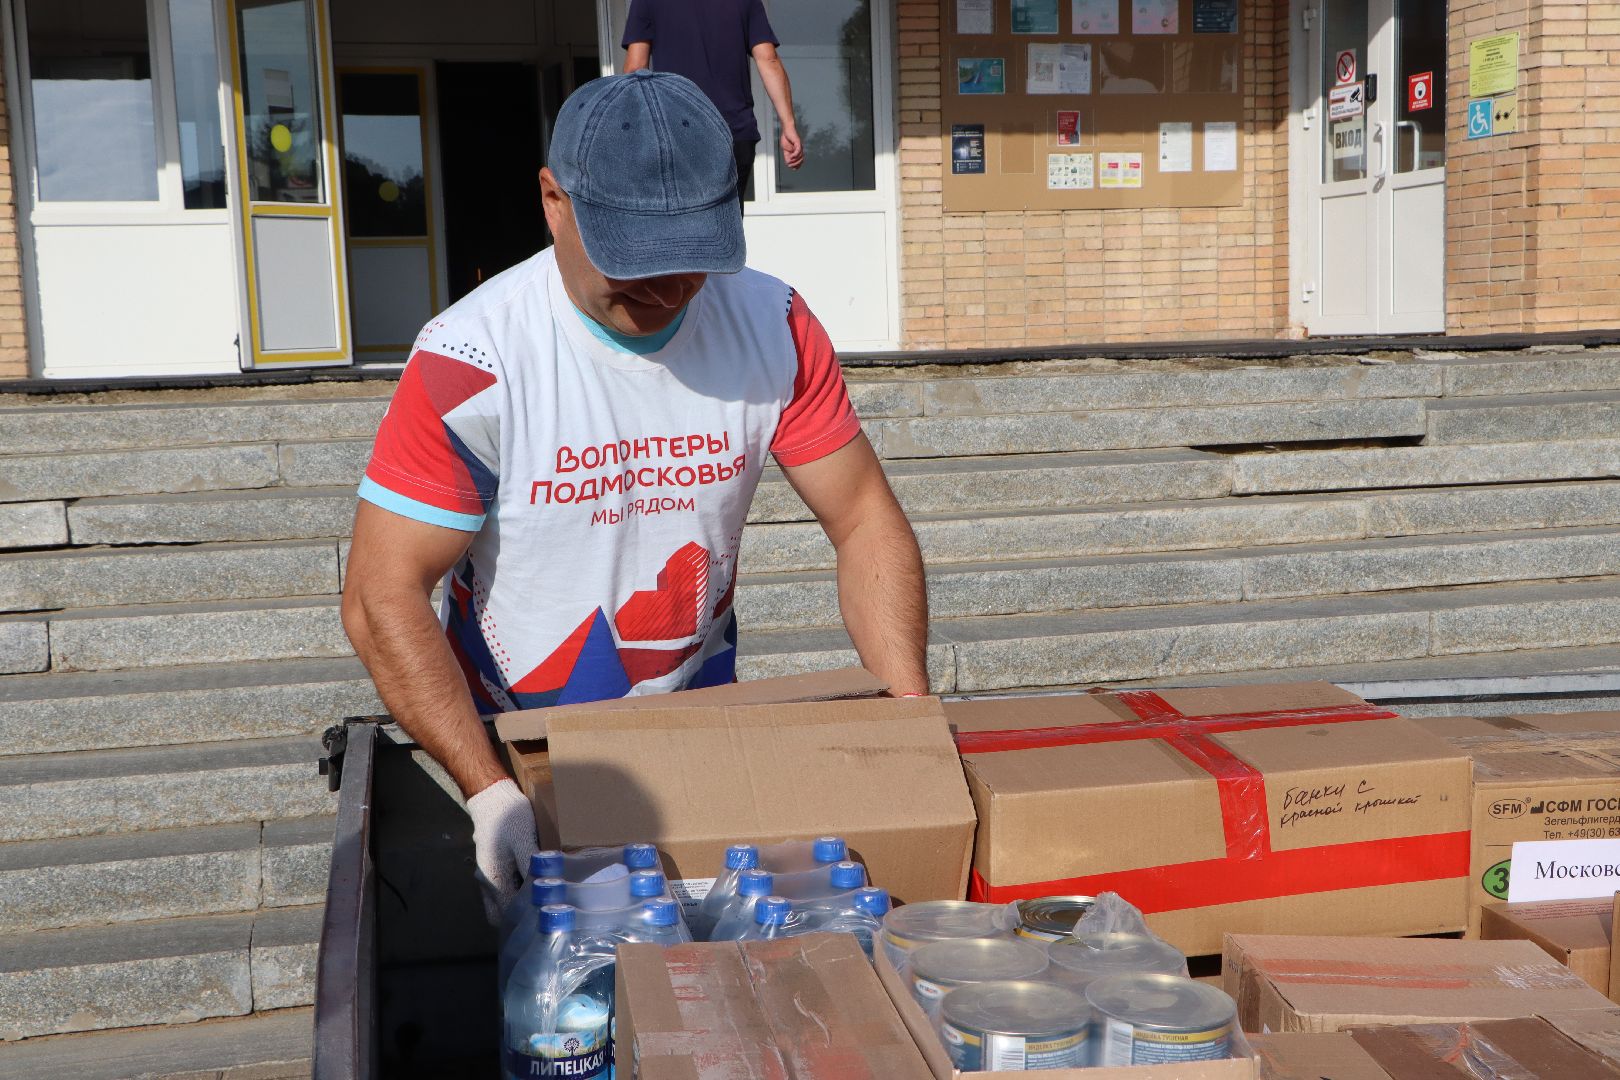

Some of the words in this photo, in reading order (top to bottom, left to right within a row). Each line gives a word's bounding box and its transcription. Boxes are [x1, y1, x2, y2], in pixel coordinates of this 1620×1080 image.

[1335, 128, 1362, 149] ВХОД
[555, 430, 730, 474] ВОЛОНТЕРЫ
[529, 453, 747, 505] ПОДМОСКОВЬЯ
[590, 504, 624, 527] МЫ
[626, 496, 696, 522] РЯДОМ
[1283, 782, 1347, 811] Банки
[1492, 803, 1522, 816] SFM
[1545, 799, 1582, 814] СФМ
[1543, 830, 1564, 840] Тел.
[529, 1051, 604, 1077] ЛИПЕЦКАЯ
